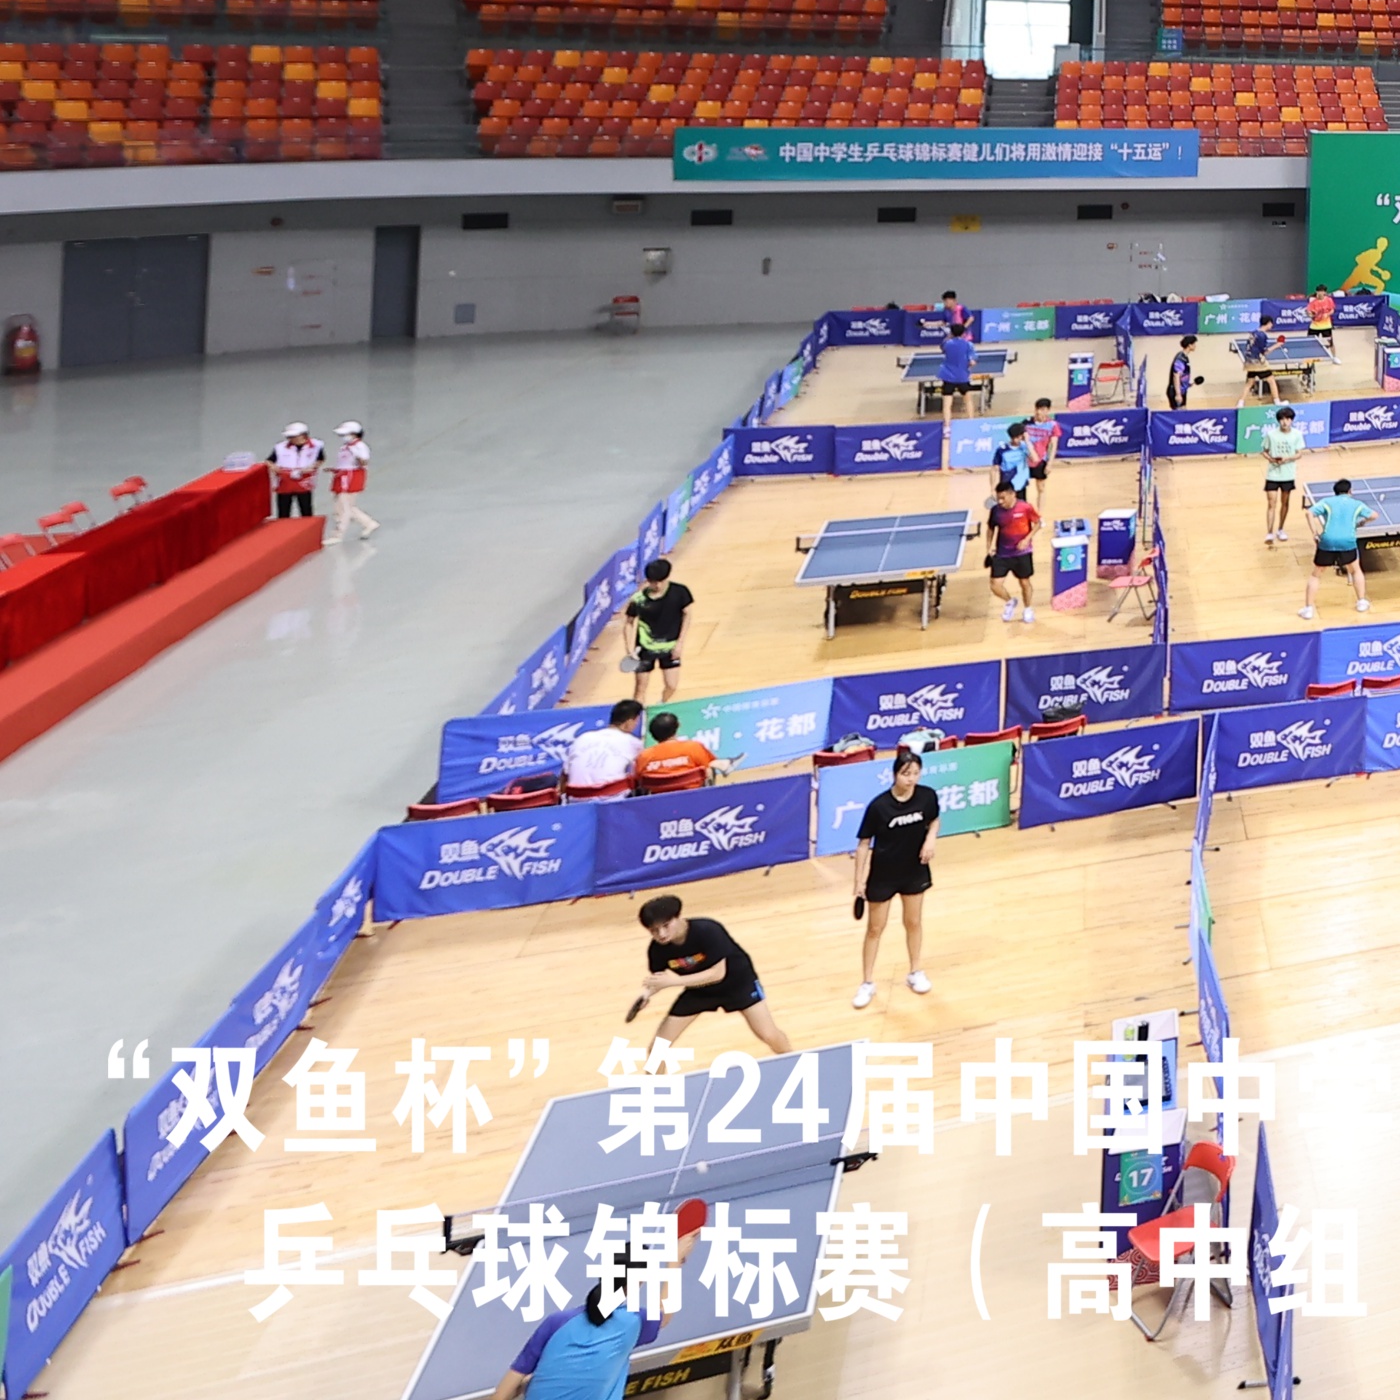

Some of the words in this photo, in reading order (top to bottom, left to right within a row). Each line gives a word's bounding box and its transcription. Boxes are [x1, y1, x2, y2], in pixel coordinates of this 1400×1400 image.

[674, 712, 817, 751] 州·花都
[866, 711, 920, 731] DOUBLE
[935, 706, 964, 722] FISH
[1237, 747, 1289, 769] DOUBLE
[1301, 743, 1332, 761] FISH
[1059, 777, 1115, 799] DOUBLE
[1130, 767, 1161, 785] FISH
[643, 839, 710, 864] DOUBLE
[730, 830, 766, 850] FISH
[418, 864, 499, 891] DOUBLE
[521, 857, 562, 876] FISH
[1129, 1168, 1153, 1188] 17
[641, 1368, 691, 1392] FISH
